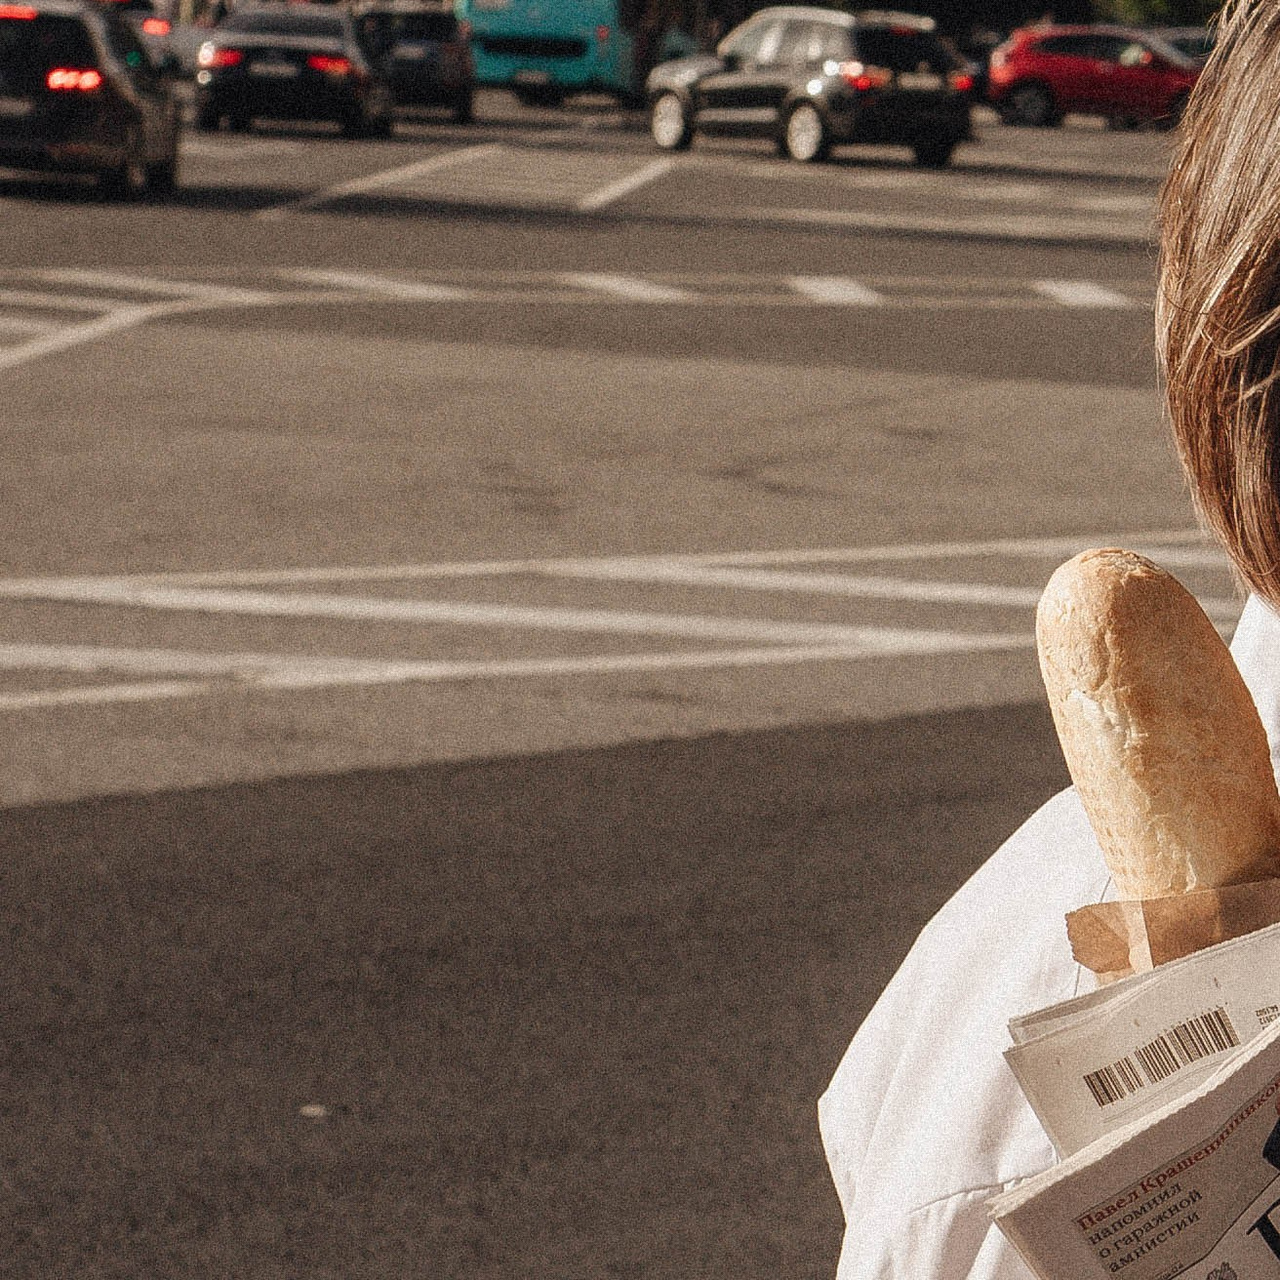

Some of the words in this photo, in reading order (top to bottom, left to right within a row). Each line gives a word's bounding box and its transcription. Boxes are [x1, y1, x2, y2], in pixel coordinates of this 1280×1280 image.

[1078, 1191, 1140, 1231] Павел
[1088, 1183, 1183, 1246] напомнил
[1100, 1248, 1111, 1259] о
[1114, 1188, 1203, 1256] гаражной
[1110, 1212, 1201, 1274] амнистии
